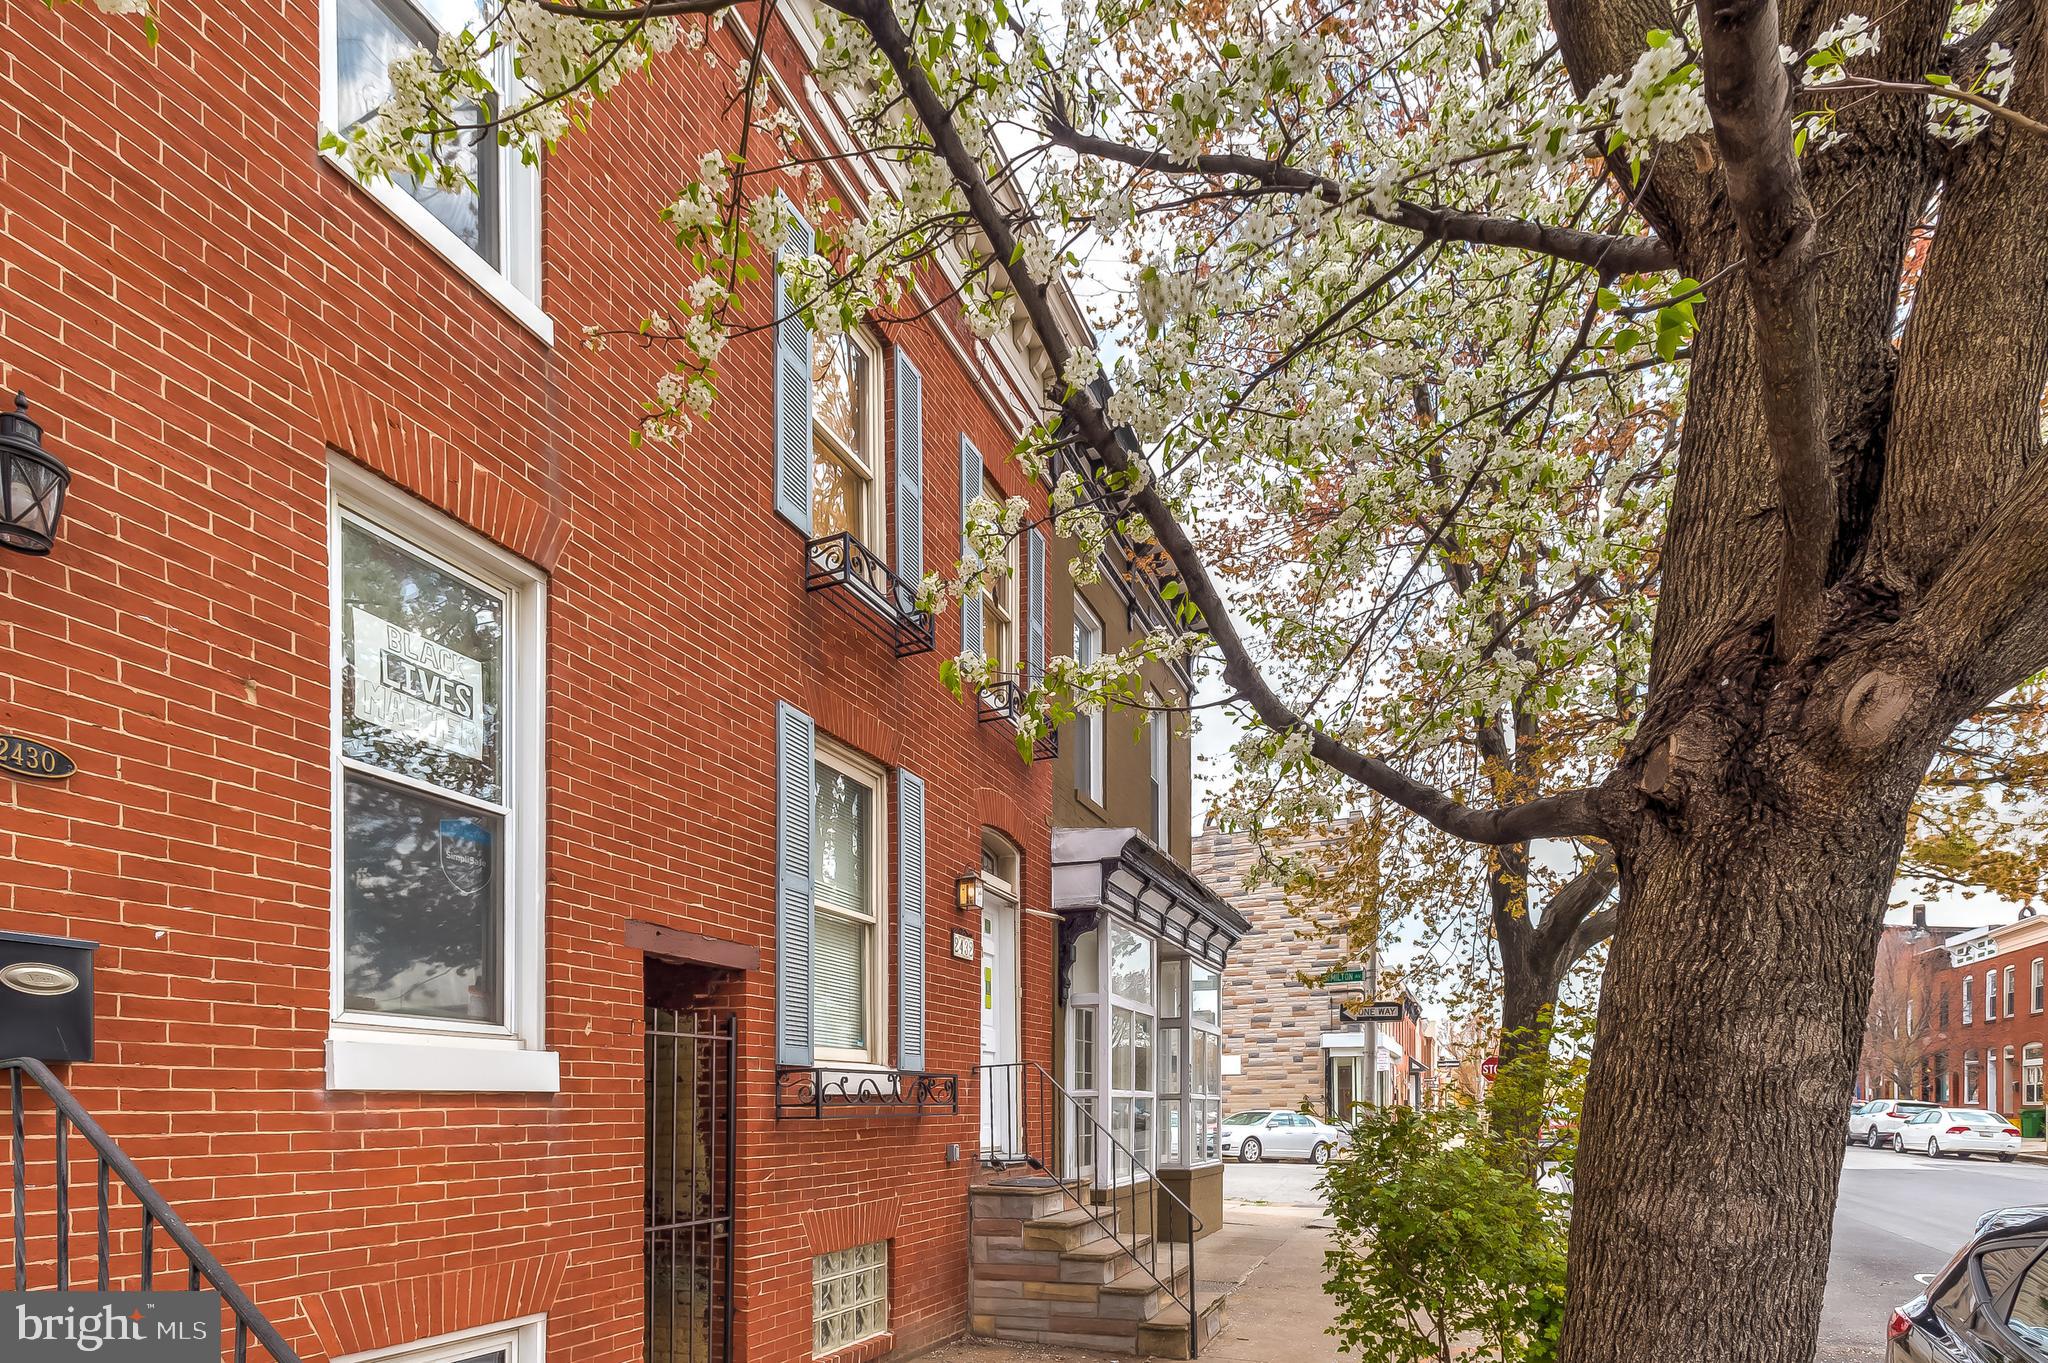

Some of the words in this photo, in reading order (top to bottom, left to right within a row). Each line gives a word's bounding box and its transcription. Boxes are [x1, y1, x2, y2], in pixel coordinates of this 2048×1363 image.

[387, 625, 465, 679] BLACK
[381, 651, 471, 717] LIVES
[364, 681, 477, 750] MATTER
[0, 738, 55, 772] 2430
[955, 936, 973, 957] 2432
[1359, 1008, 1375, 1016] ONE
[1378, 1007, 1396, 1015] WAY
